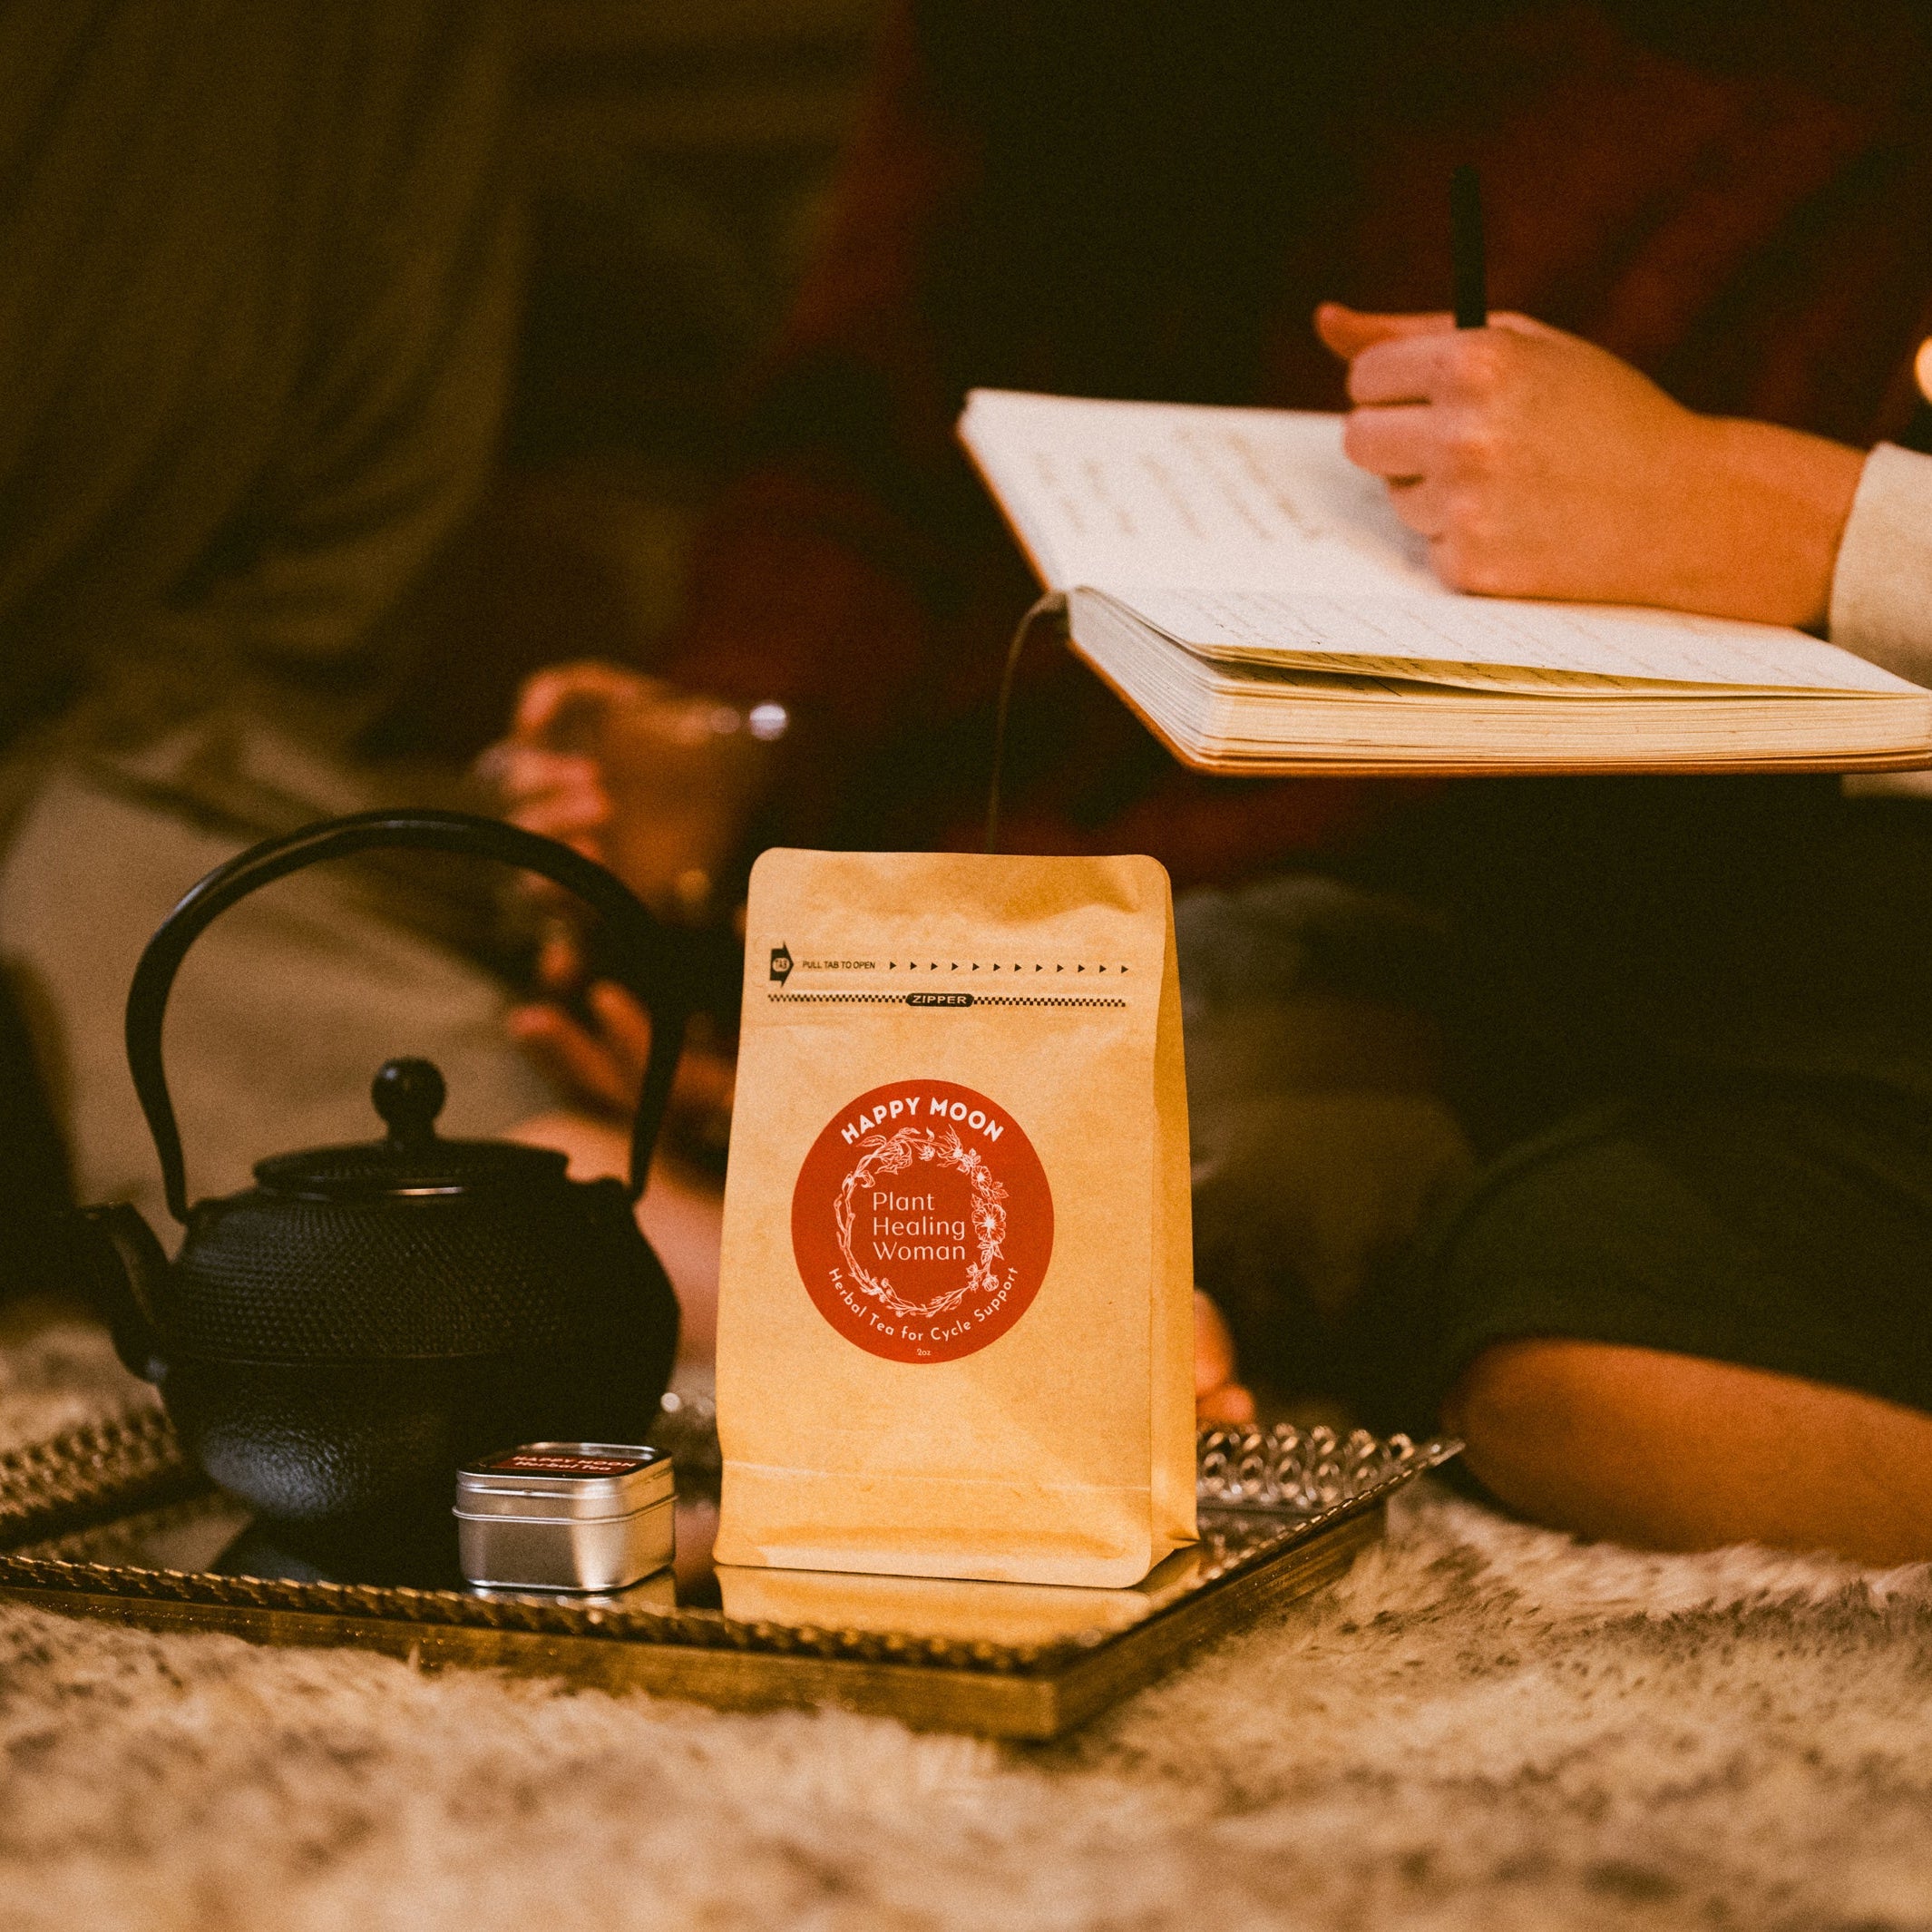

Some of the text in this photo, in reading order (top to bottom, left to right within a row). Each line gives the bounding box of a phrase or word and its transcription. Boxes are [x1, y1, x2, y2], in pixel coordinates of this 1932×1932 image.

[802, 961, 876, 970] PULL TAB TO OPEN
[912, 993, 968, 1006] ZIPPER
[840, 1097, 1004, 1145] HAPPY MOON
[873, 1191, 935, 1212] Plant
[873, 1215, 966, 1241] Healing
[873, 1241, 966, 1261] Woman
[828, 1266, 1019, 1342] Herbal Tea for Cycle Support
[916, 1347, 932, 1356] 2oz
